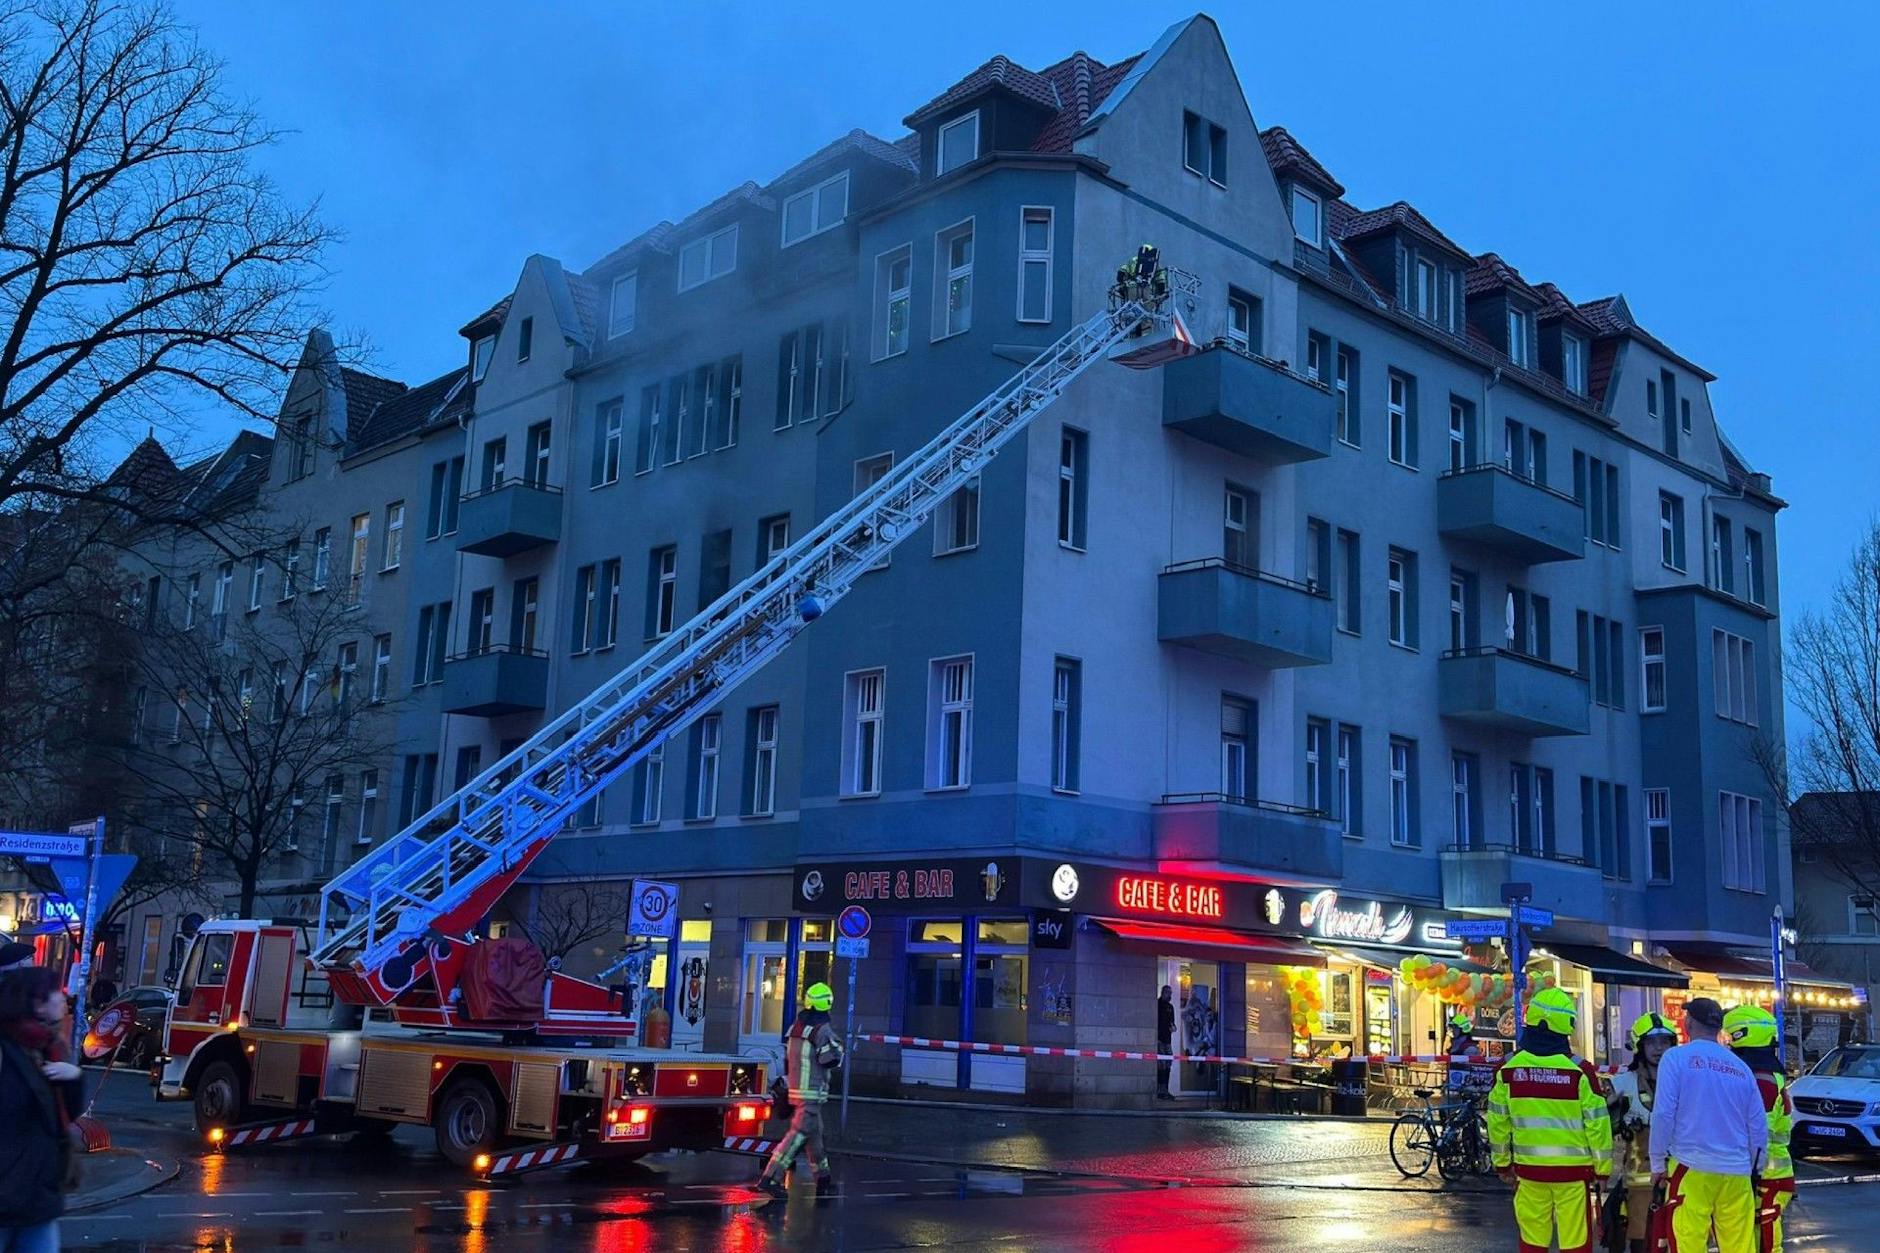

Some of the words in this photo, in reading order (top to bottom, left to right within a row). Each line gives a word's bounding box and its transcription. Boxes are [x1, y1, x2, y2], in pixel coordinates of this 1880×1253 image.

[0, 836, 80, 853] Residenzstraße
[844, 871, 890, 900] CAFE
[894, 870, 910, 899] &
[914, 869, 954, 898] BAR
[645, 895, 663, 913] 30
[1119, 877, 1165, 912] CAFE
[1168, 882, 1183, 913] &
[1186, 885, 1222, 917] BAR
[640, 923, 663, 934] ZONE
[1038, 918, 1063, 940] sky
[1529, 1074, 1571, 1085] FEUERWEHR
[1708, 1062, 1747, 1080] FEUERWEHR
